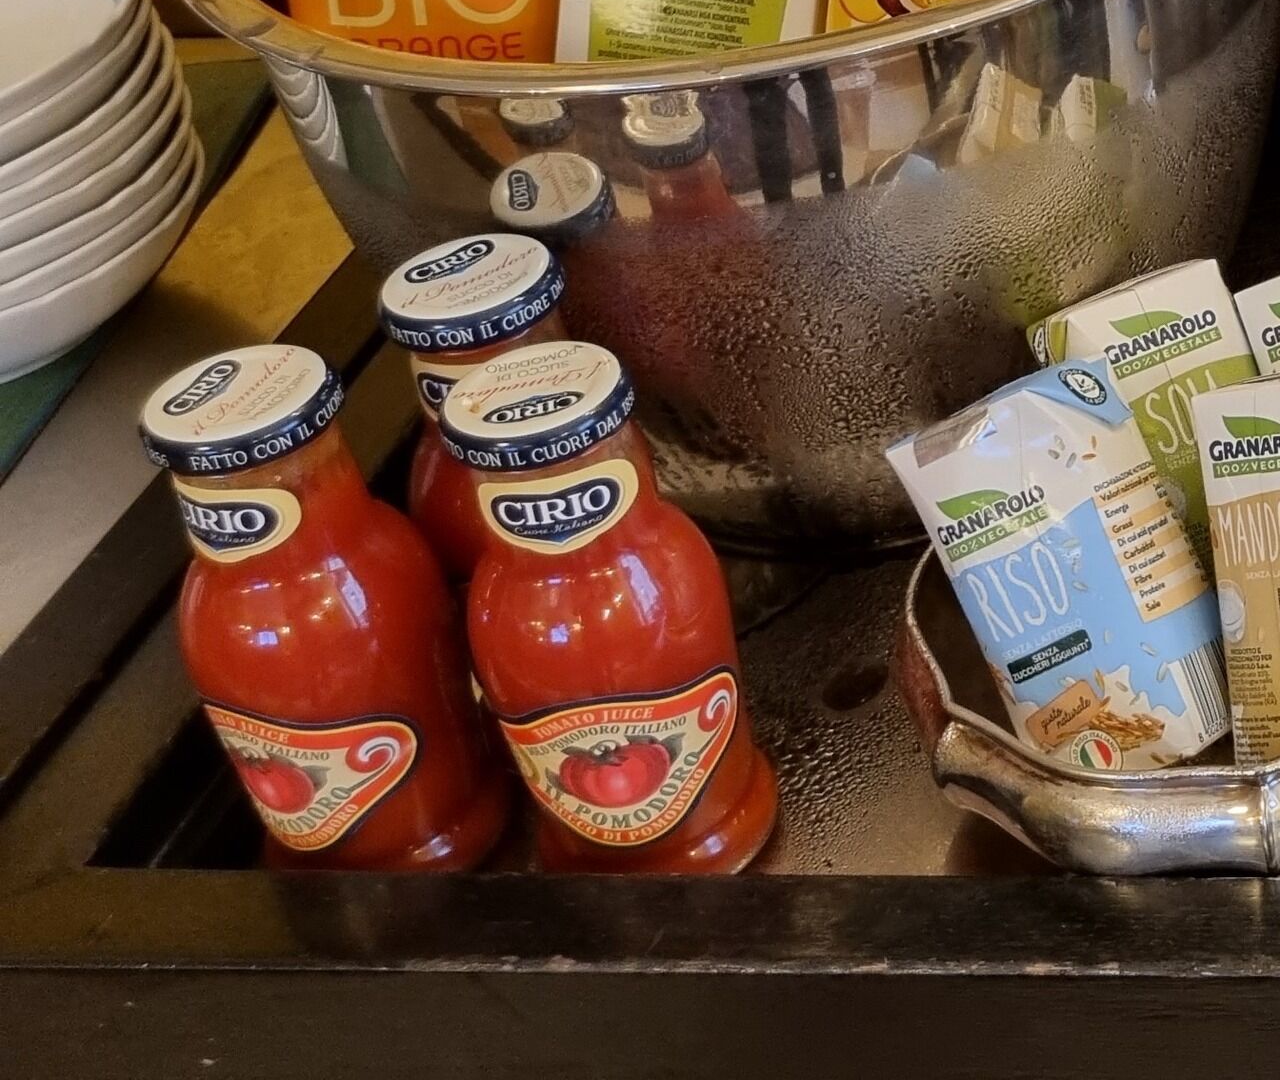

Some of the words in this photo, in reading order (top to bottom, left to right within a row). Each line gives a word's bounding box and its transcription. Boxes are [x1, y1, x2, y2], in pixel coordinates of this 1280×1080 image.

[411, 242, 488, 281] CIRIO
[389, 324, 432, 347] FATTO
[436, 327, 475, 347] CON
[502, 294, 550, 331] CUORE
[1103, 309, 1217, 366] GRANAROLO
[169, 363, 234, 413] CIRIO
[490, 394, 579, 424] CIRIO
[189, 450, 248, 471] FATTO
[253, 433, 294, 460] CON
[299, 422, 314, 442] IL
[467, 449, 501, 467] CON
[508, 448, 527, 467] IL
[531, 430, 593, 464] CUORE
[596, 411, 622, 438] DAL
[498, 484, 612, 527] CIRIO
[937, 484, 1045, 546] GRANAROLO
[966, 540, 1071, 643] RISO
[1144, 600, 1162, 613] Sale
[1011, 659, 1050, 682] ZUCCHERI
[1031, 645, 1060, 664] SENZA
[240, 719, 290, 744] JUICE
[532, 711, 596, 740] TOMATO
[600, 706, 655, 723] JUICE
[549, 723, 621, 754] POMODORO
[623, 715, 688, 736] ITALIANO
[261, 741, 331, 762] ITALIANO
[572, 750, 701, 831] POMODORO
[601, 831, 623, 842] DI
[628, 766, 706, 842] POMODORO
